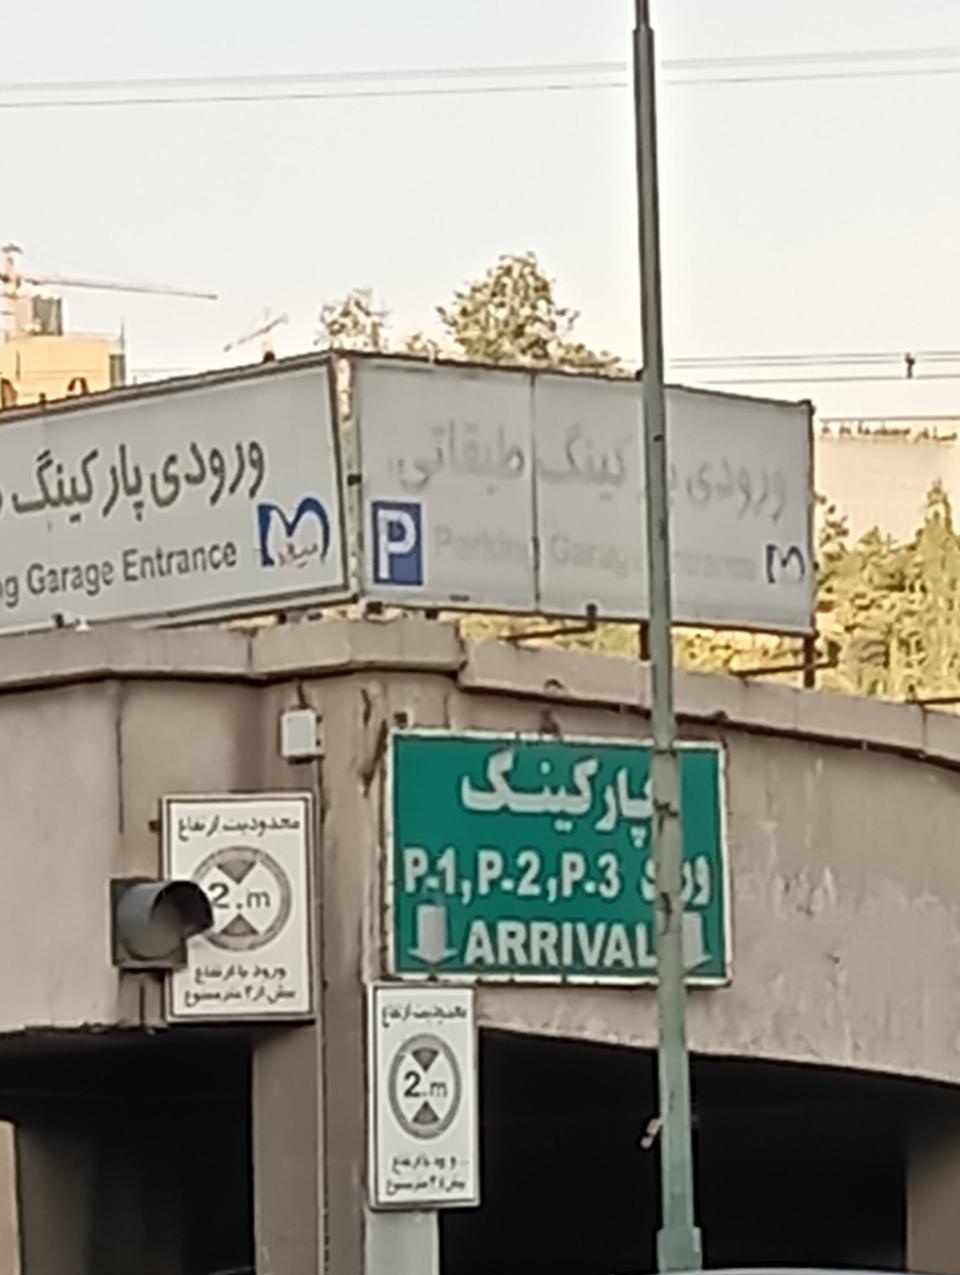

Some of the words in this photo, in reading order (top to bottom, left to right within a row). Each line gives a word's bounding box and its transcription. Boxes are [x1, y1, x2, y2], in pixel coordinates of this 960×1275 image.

[10, 443, 144, 522] پارکینگ
[150, 440, 265, 508] ورودی
[26, 560, 115, 596] Garage
[122, 540, 238, 583] Entrance
[378, 508, 417, 580] P
